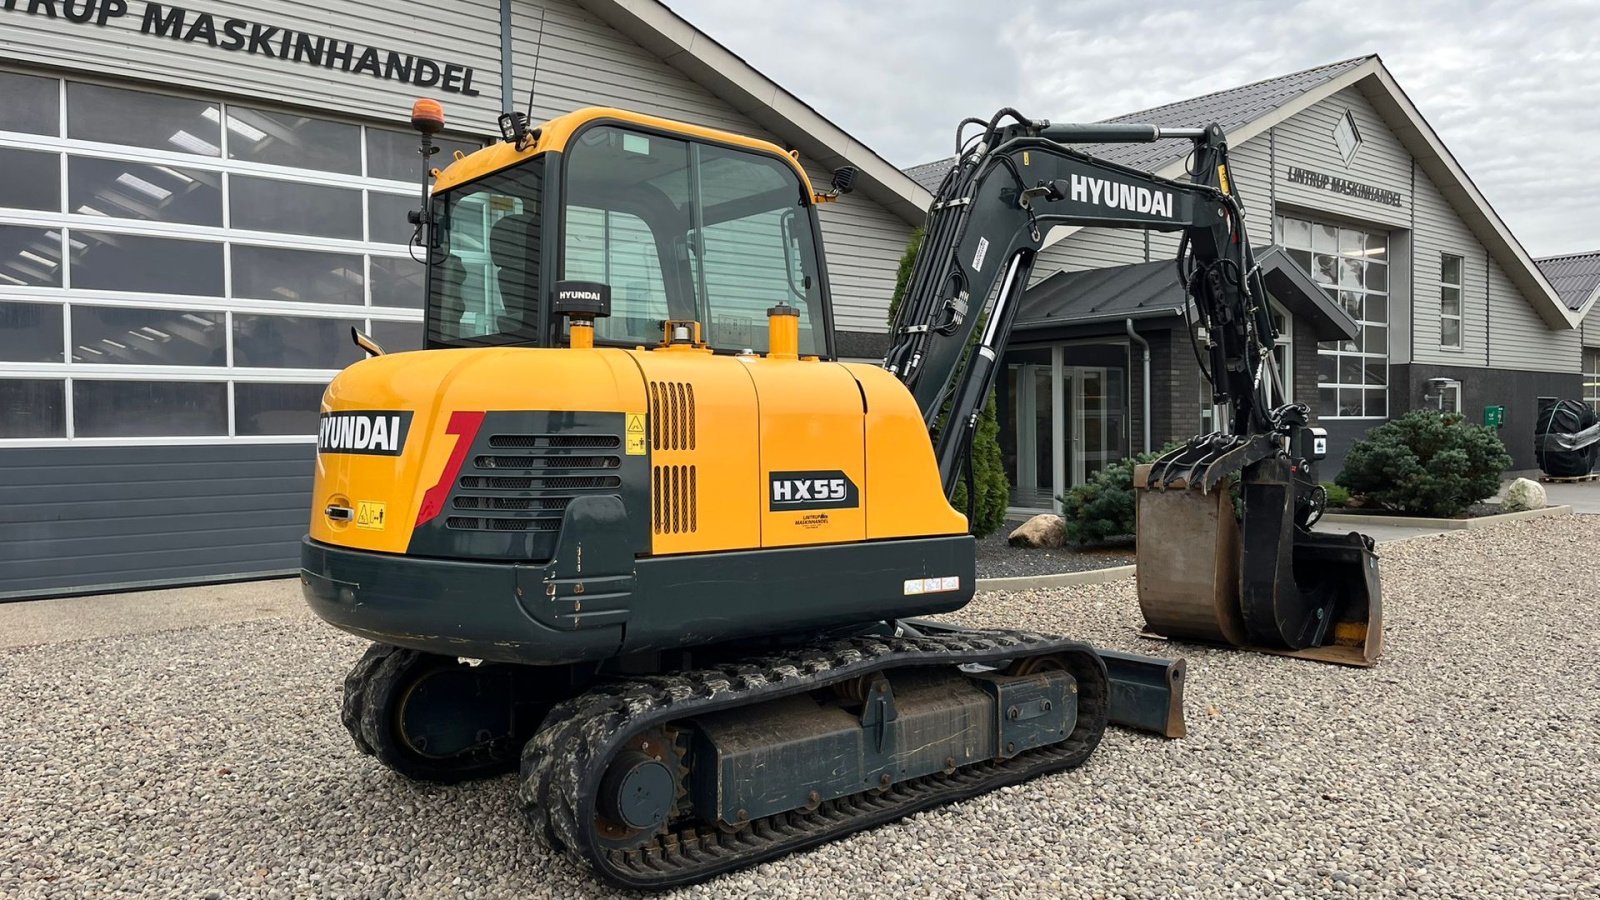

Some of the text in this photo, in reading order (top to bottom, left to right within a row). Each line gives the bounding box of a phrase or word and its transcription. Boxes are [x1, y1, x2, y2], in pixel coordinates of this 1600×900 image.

[140, 3, 480, 96] MASKINHANDEL
[1071, 173, 1173, 218] HYUNDAI
[1287, 166, 1402, 207] LINTRUP MASKINHANDEL
[559, 291, 600, 301] HYUNDAI
[318, 415, 400, 451] HYUNDAI
[773, 479, 844, 501] HX55
